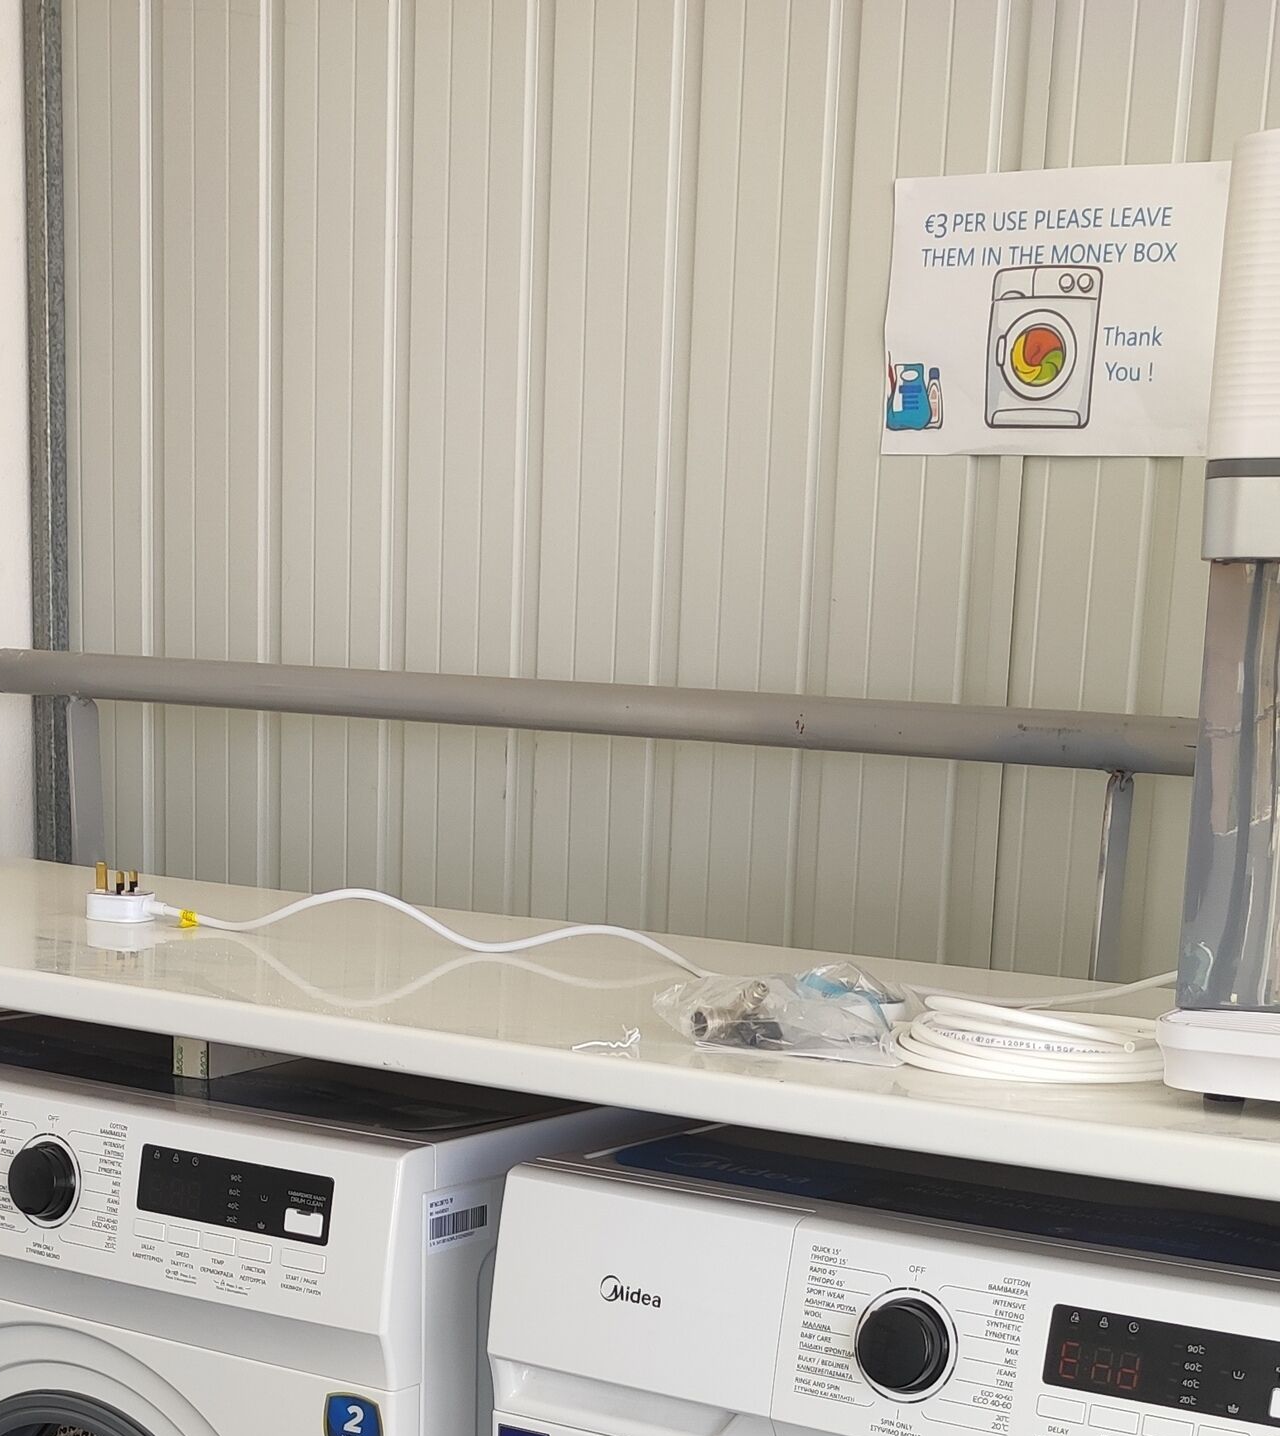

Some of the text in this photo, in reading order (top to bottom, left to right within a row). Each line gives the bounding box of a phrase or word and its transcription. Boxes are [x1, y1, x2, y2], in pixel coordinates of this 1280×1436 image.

[924, 207, 1173, 238] €3 PER USE PLEASE LEAVE
[921, 242, 1179, 268] THEM IN THE MONEY BOX
[1103, 326, 1163, 347] Thank
[1104, 362, 1141, 383] You
[48, 1114, 60, 1123] OFF
[812, 1245, 831, 1255] QUICK
[210, 1257, 225, 1266] TEMP
[809, 1265, 827, 1275] RAPID
[908, 1265, 926, 1275] OFF
[1003, 1277, 1031, 1288] COTTON
[600, 1275, 662, 1308] Midea
[806, 1287, 845, 1300] SPORT WEAR
[992, 1299, 1027, 1311] INTENSIVE
[804, 1309, 822, 1319] WOOL
[986, 1320, 1022, 1332] SYNTHETIC
[800, 1331, 832, 1344] BABY CARE
[1006, 1347, 1019, 1356] MIX
[996, 1368, 1017, 1379] JEANS
[812, 1381, 826, 1389] AND
[826, 1384, 841, 1392] SPIN
[980, 1389, 994, 1398] ECO
[972, 1395, 1012, 1410] ECO 40-60
[343, 1405, 364, 1434] 2
[880, 1417, 913, 1431] SPIN ONLY
[1047, 1425, 1069, 1435] DELAY
